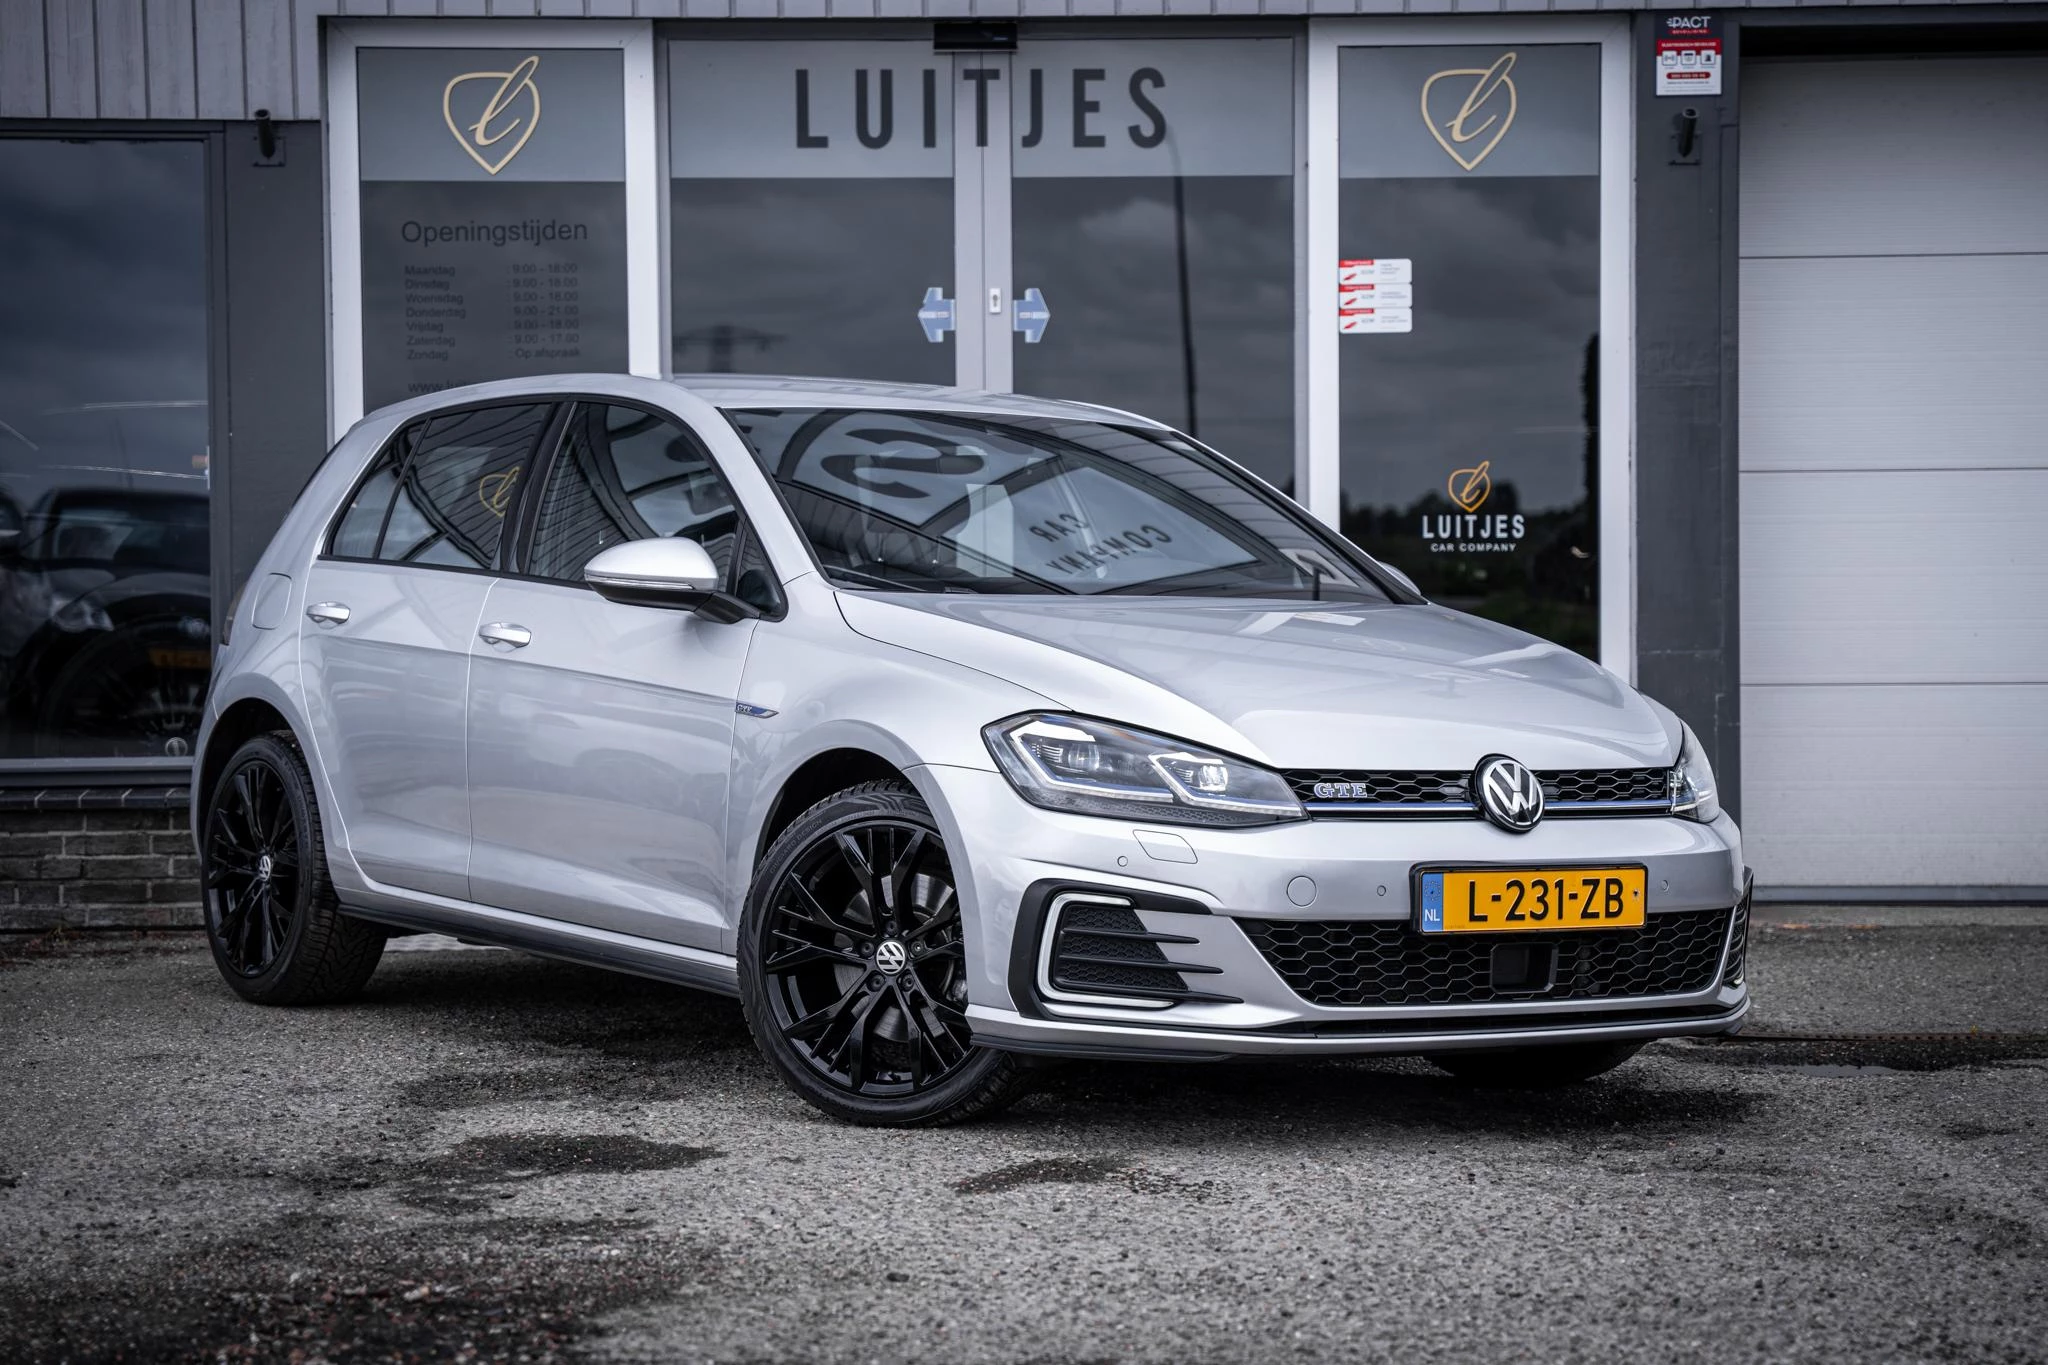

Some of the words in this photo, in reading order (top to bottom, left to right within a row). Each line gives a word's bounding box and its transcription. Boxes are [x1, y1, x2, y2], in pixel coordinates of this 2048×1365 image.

[1667, 16, 1711, 29] PACT
[795, 67, 1168, 150] LUITJES
[402, 219, 588, 247] Openingstijden
[1422, 514, 1525, 540] LUITJES
[1430, 543, 1455, 553] CAR
[1458, 543, 1517, 553] COMPANY
[1313, 782, 1368, 799] GTE
[1469, 877, 1625, 922] L-231-ZB
[1424, 909, 1441, 922] NL
